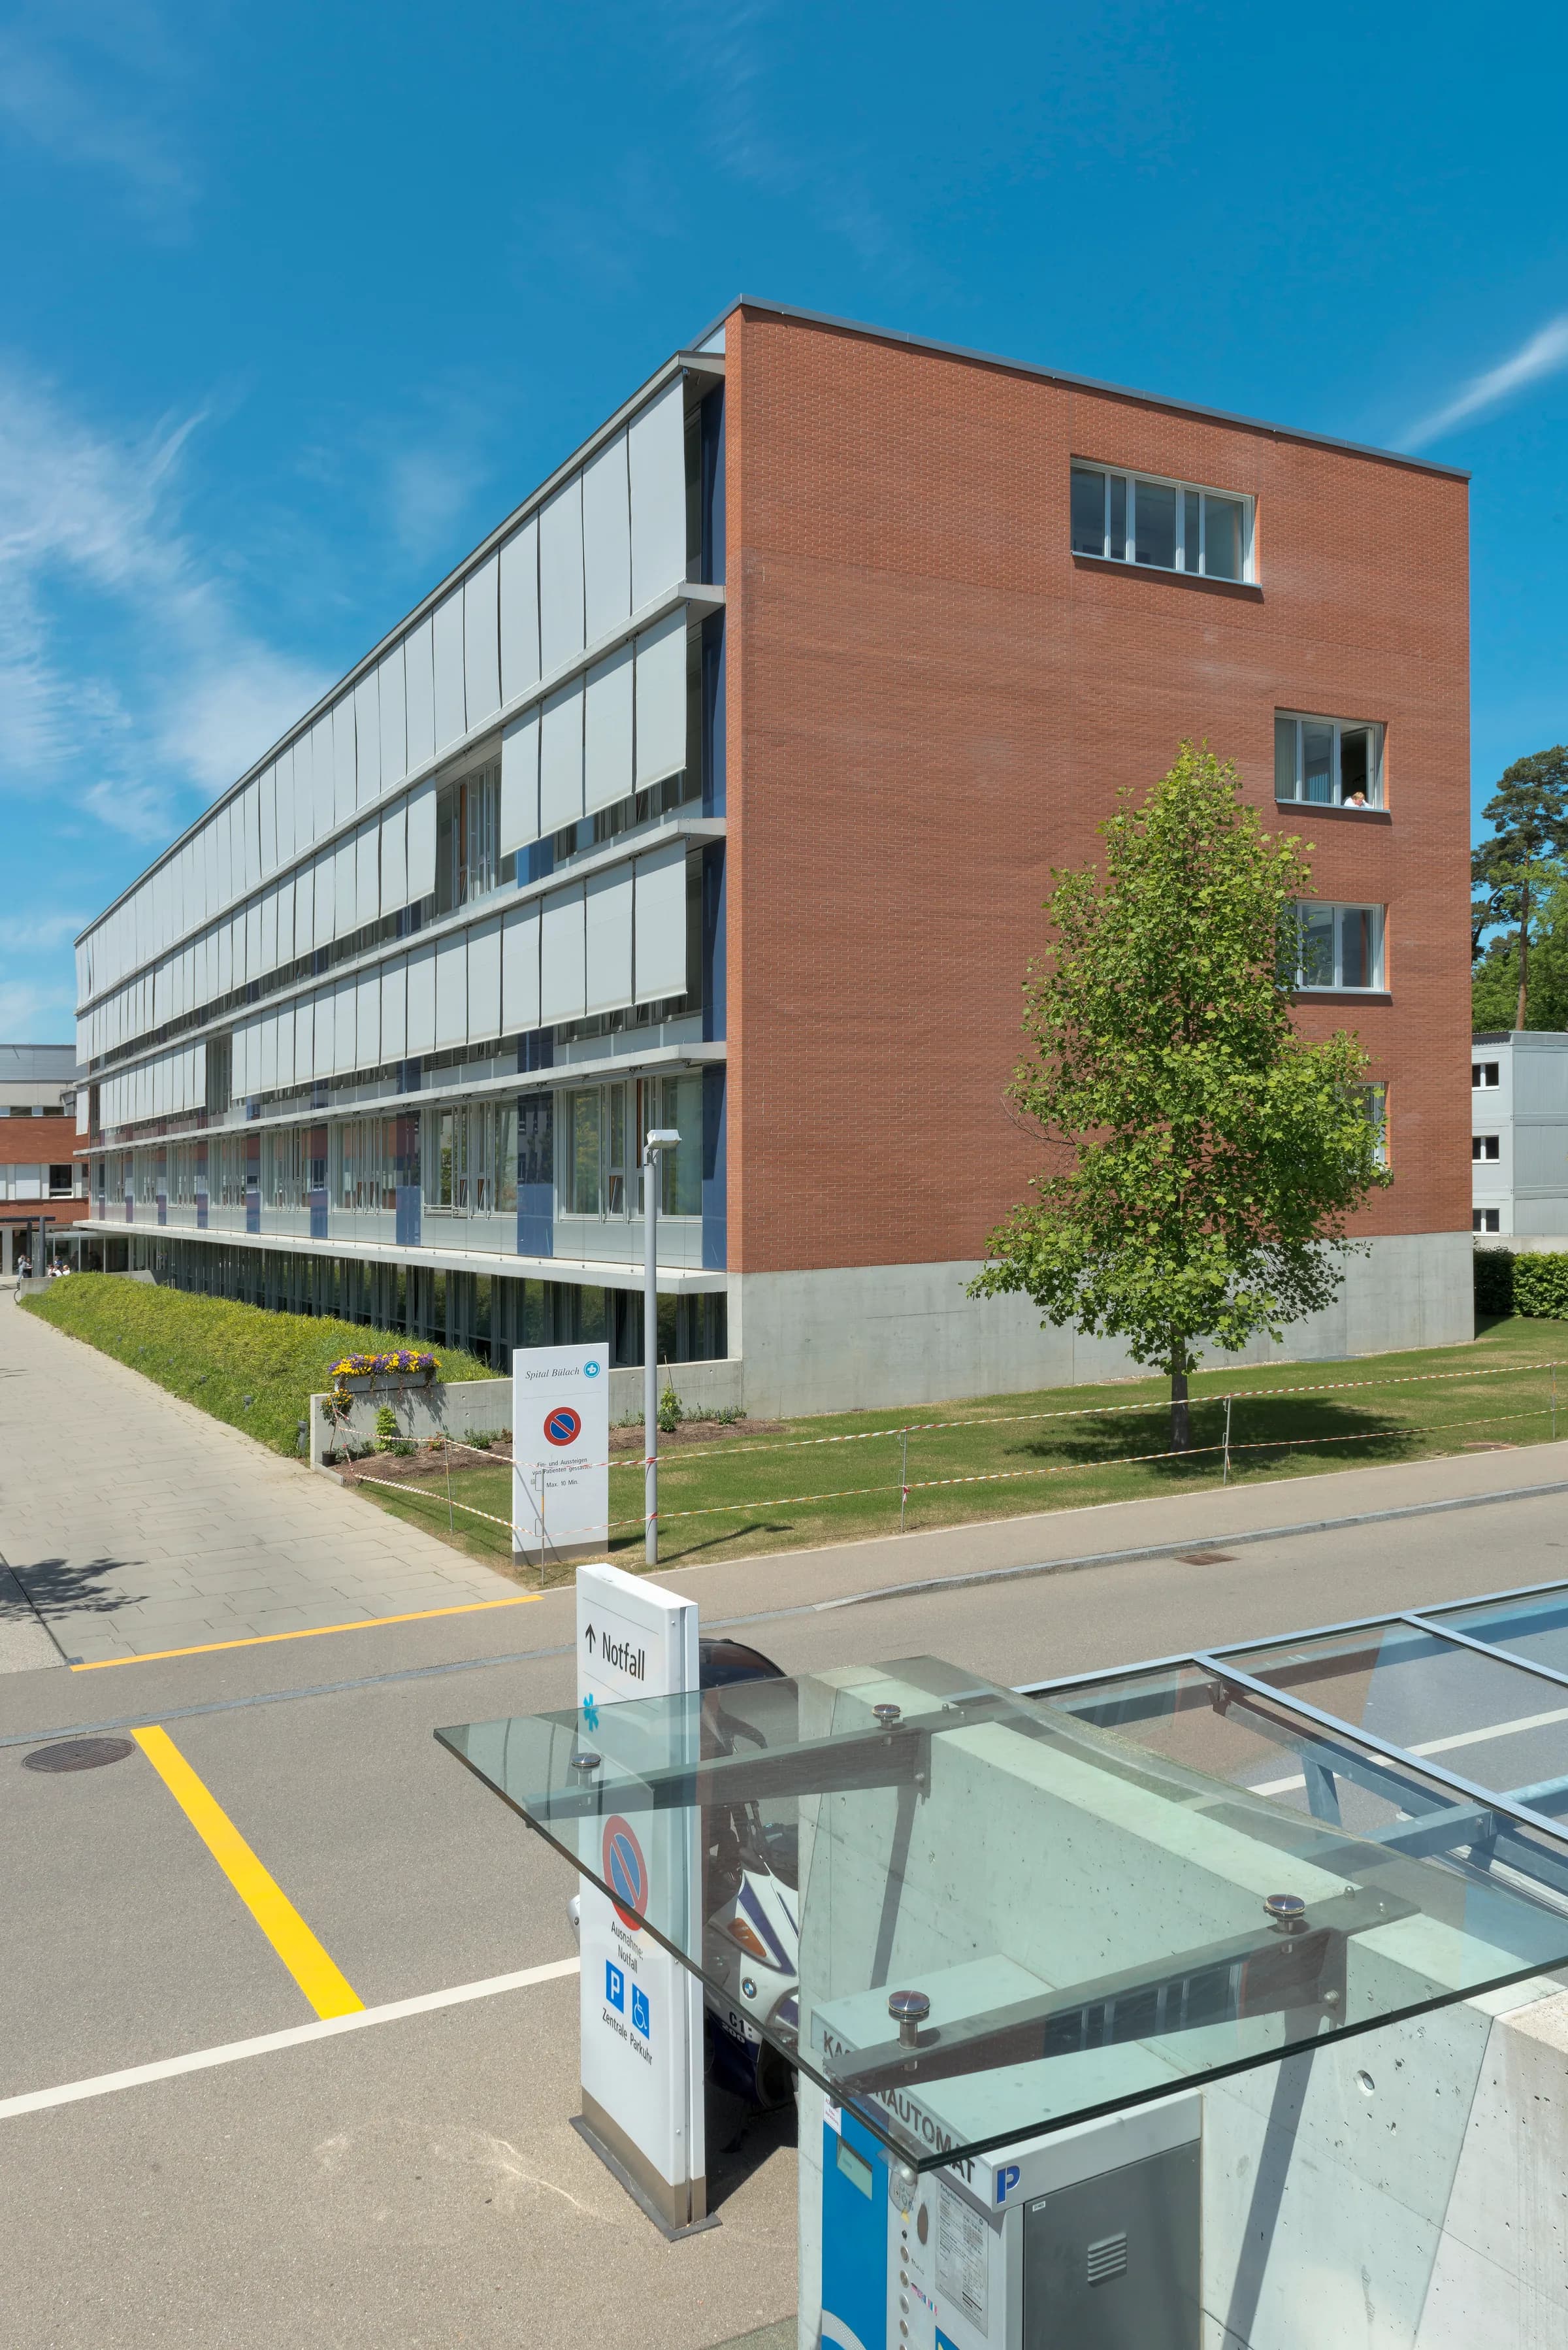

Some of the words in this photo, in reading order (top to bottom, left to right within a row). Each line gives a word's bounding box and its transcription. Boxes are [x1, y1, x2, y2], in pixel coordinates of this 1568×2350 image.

[525, 1369, 549, 1380] Spital
[552, 1366, 580, 1377] Bülach
[602, 1631, 645, 1681] Notfall
[611, 1921, 644, 1961] Ausnahme:
[618, 1944, 638, 1974] Notfall
[611, 1970, 620, 2000] P
[602, 2008, 627, 2041] Zentrale
[630, 2032, 653, 2066] Parkuhr
[996, 2164, 1021, 2204] P
